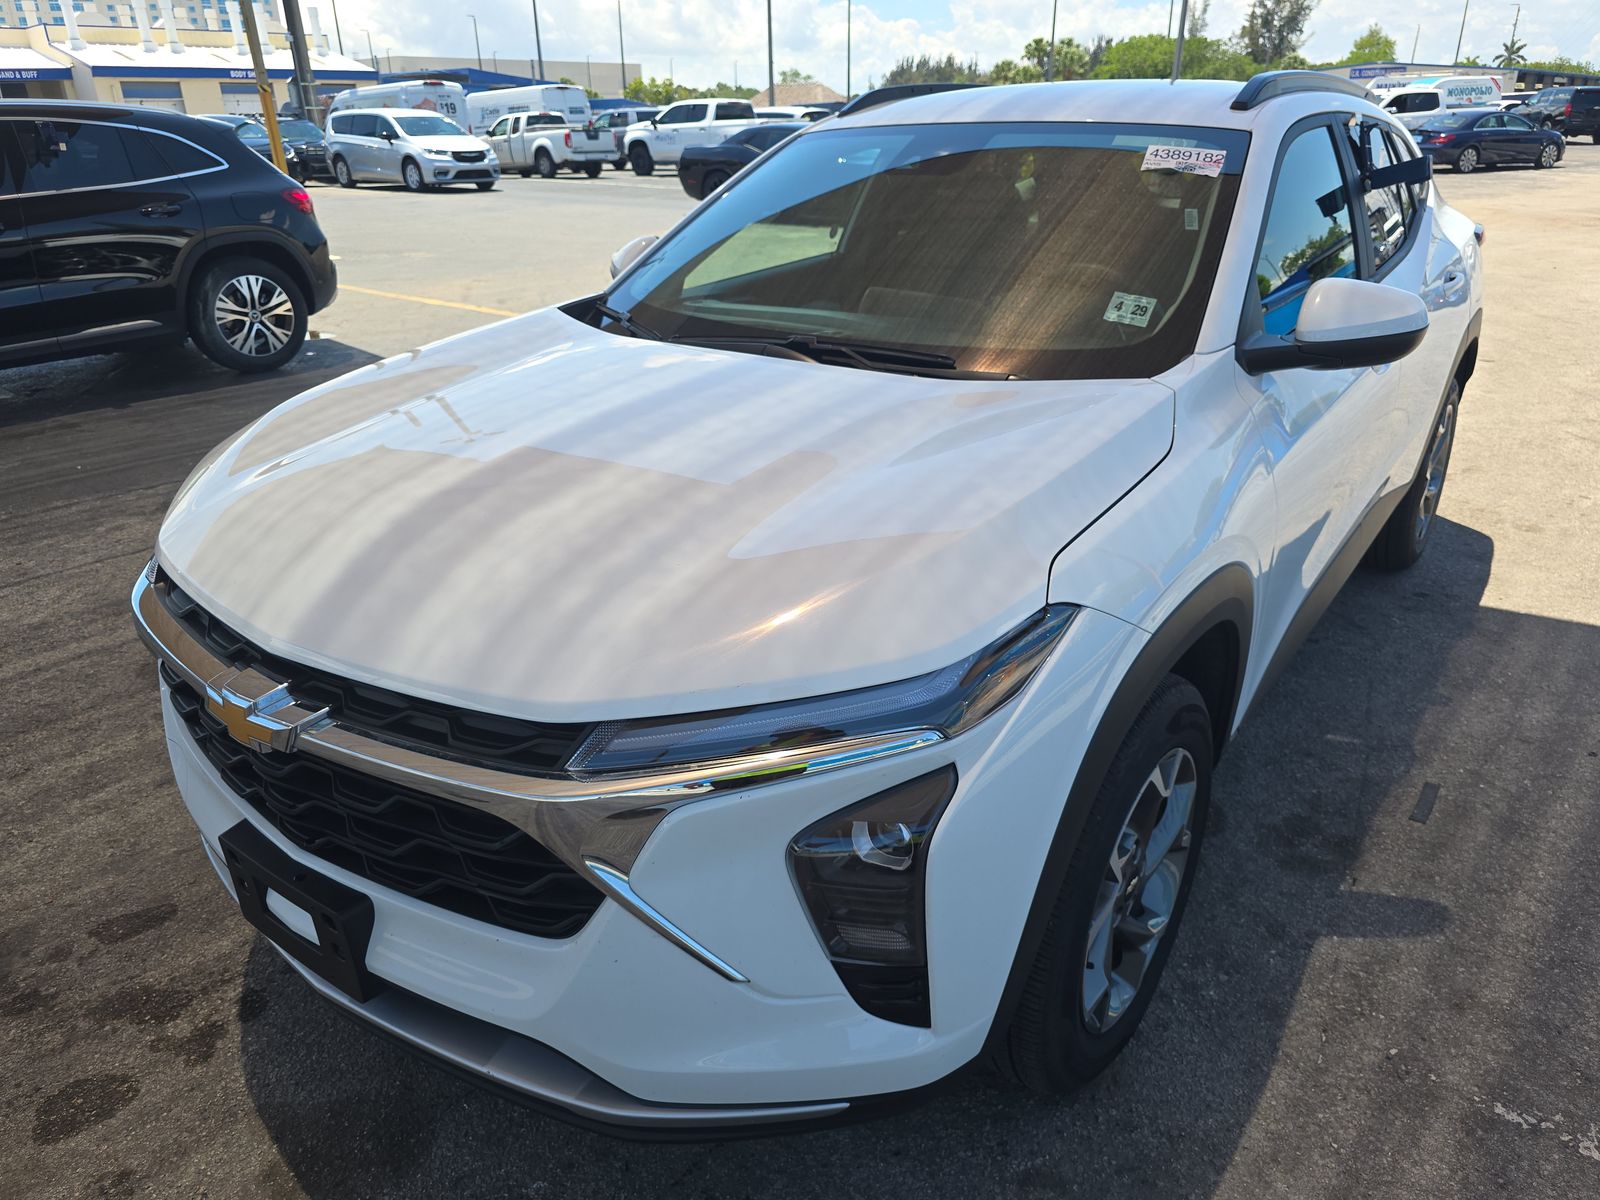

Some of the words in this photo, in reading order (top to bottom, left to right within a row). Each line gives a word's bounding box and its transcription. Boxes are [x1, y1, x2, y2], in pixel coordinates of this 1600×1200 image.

[15, 71, 21, 79] &
[21, 70, 38, 79] BUFF
[230, 70, 246, 78] BODY
[1149, 148, 1225, 165] 4389182
[1114, 300, 1124, 312] 4
[1130, 304, 1148, 317] 29
